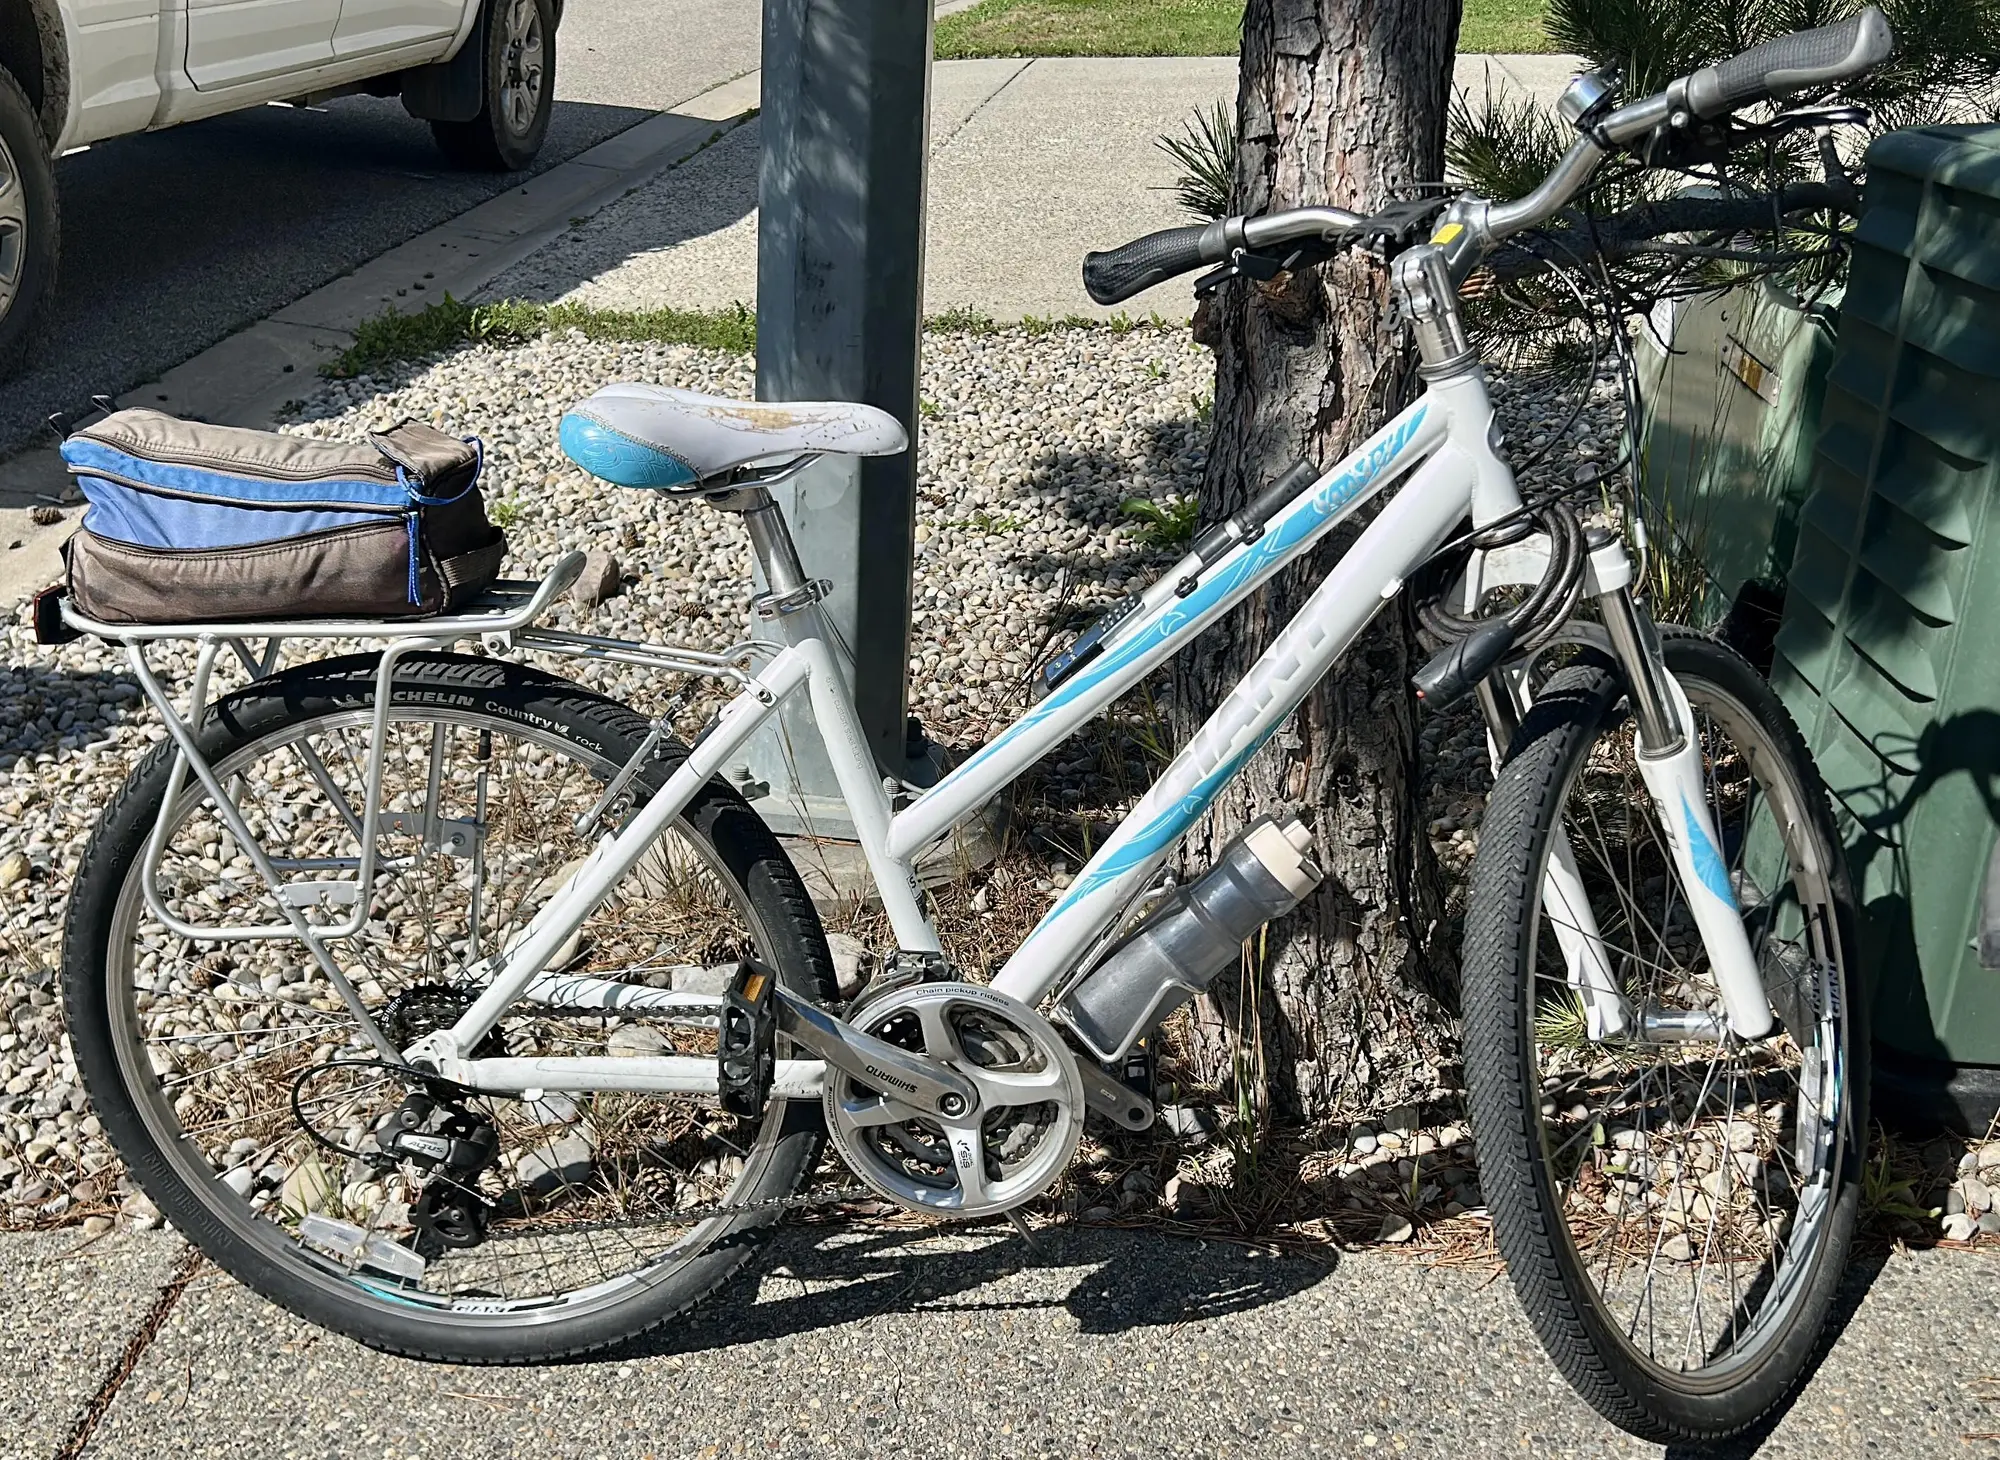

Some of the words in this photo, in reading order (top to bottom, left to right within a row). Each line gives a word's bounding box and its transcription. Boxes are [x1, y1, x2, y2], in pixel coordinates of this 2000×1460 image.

[364, 691, 475, 706] MCHELIN
[485, 700, 553, 729] Country
[575, 735, 603, 753] rock
[1153, 589, 1326, 813] GIANT
[916, 987, 943, 996] Chain
[945, 987, 978, 996] pickup
[865, 1064, 919, 1094] SHIMANO
